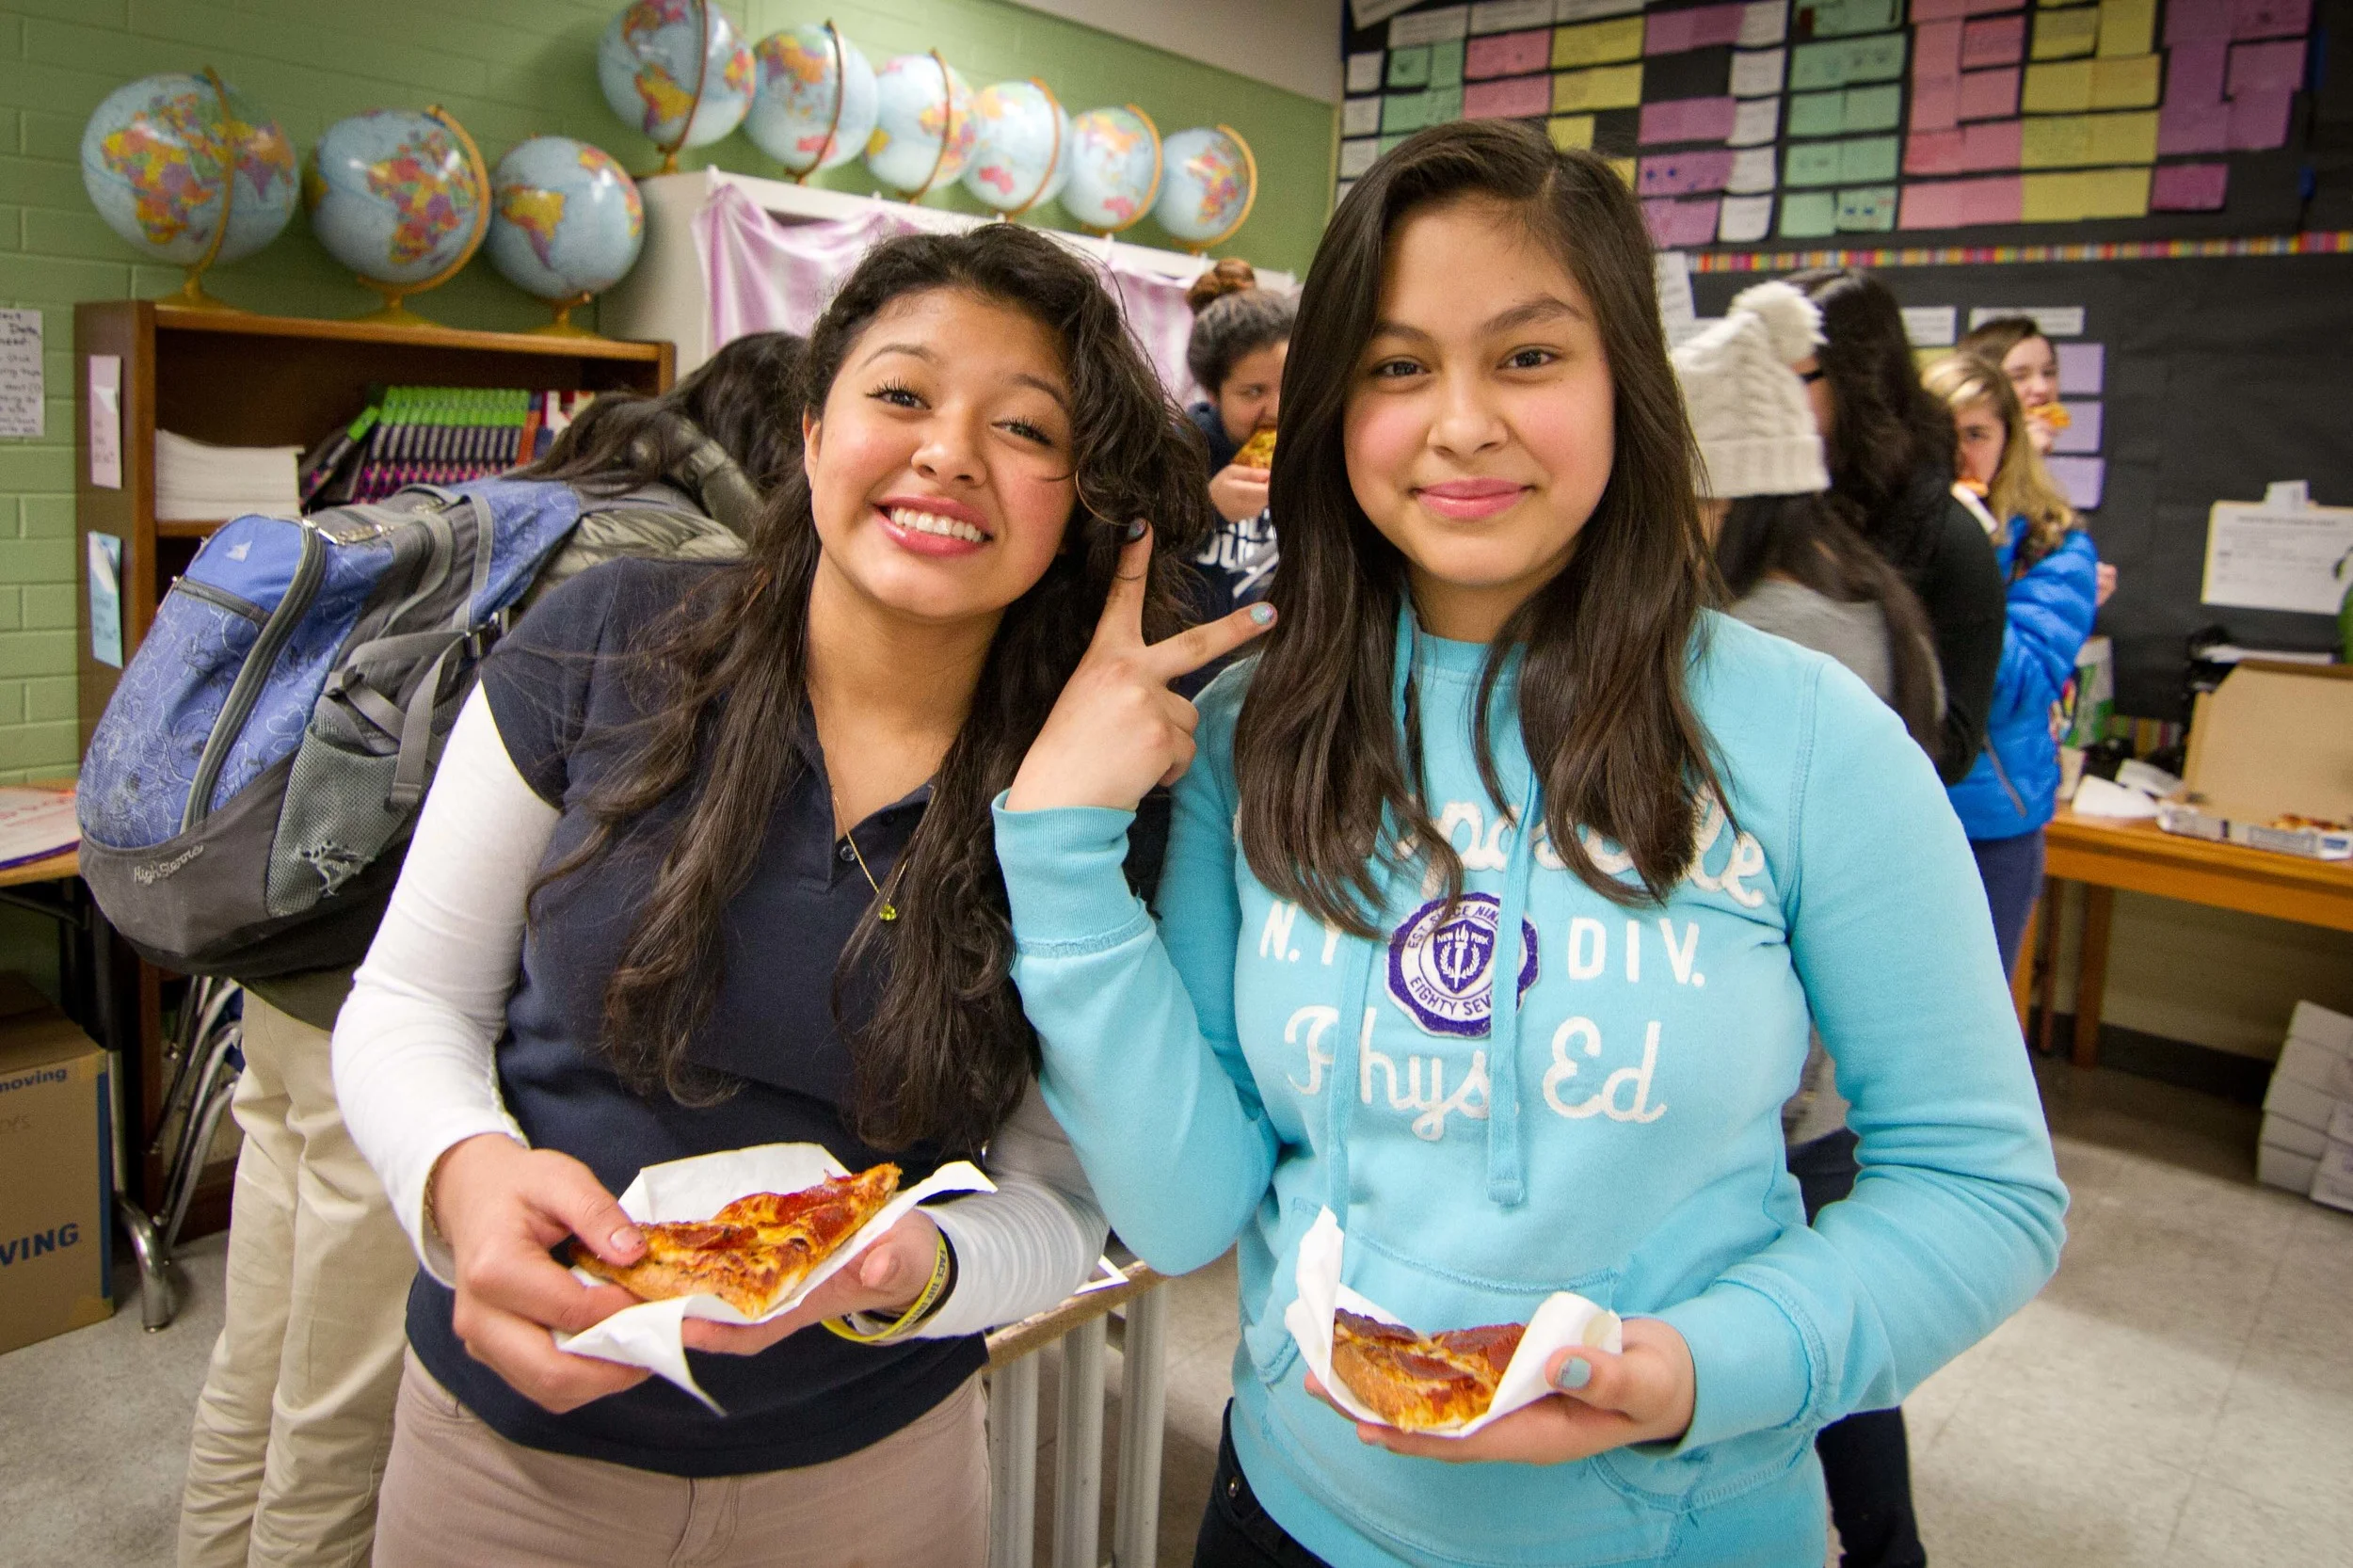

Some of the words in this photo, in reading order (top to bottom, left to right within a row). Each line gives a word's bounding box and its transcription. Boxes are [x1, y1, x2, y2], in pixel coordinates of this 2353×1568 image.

[1569, 918, 1705, 987] DIV.
[1410, 977, 1457, 1016] EIGHTY
[1464, 994, 1492, 1016] SEV
[1543, 1016, 1668, 1125] Ed
